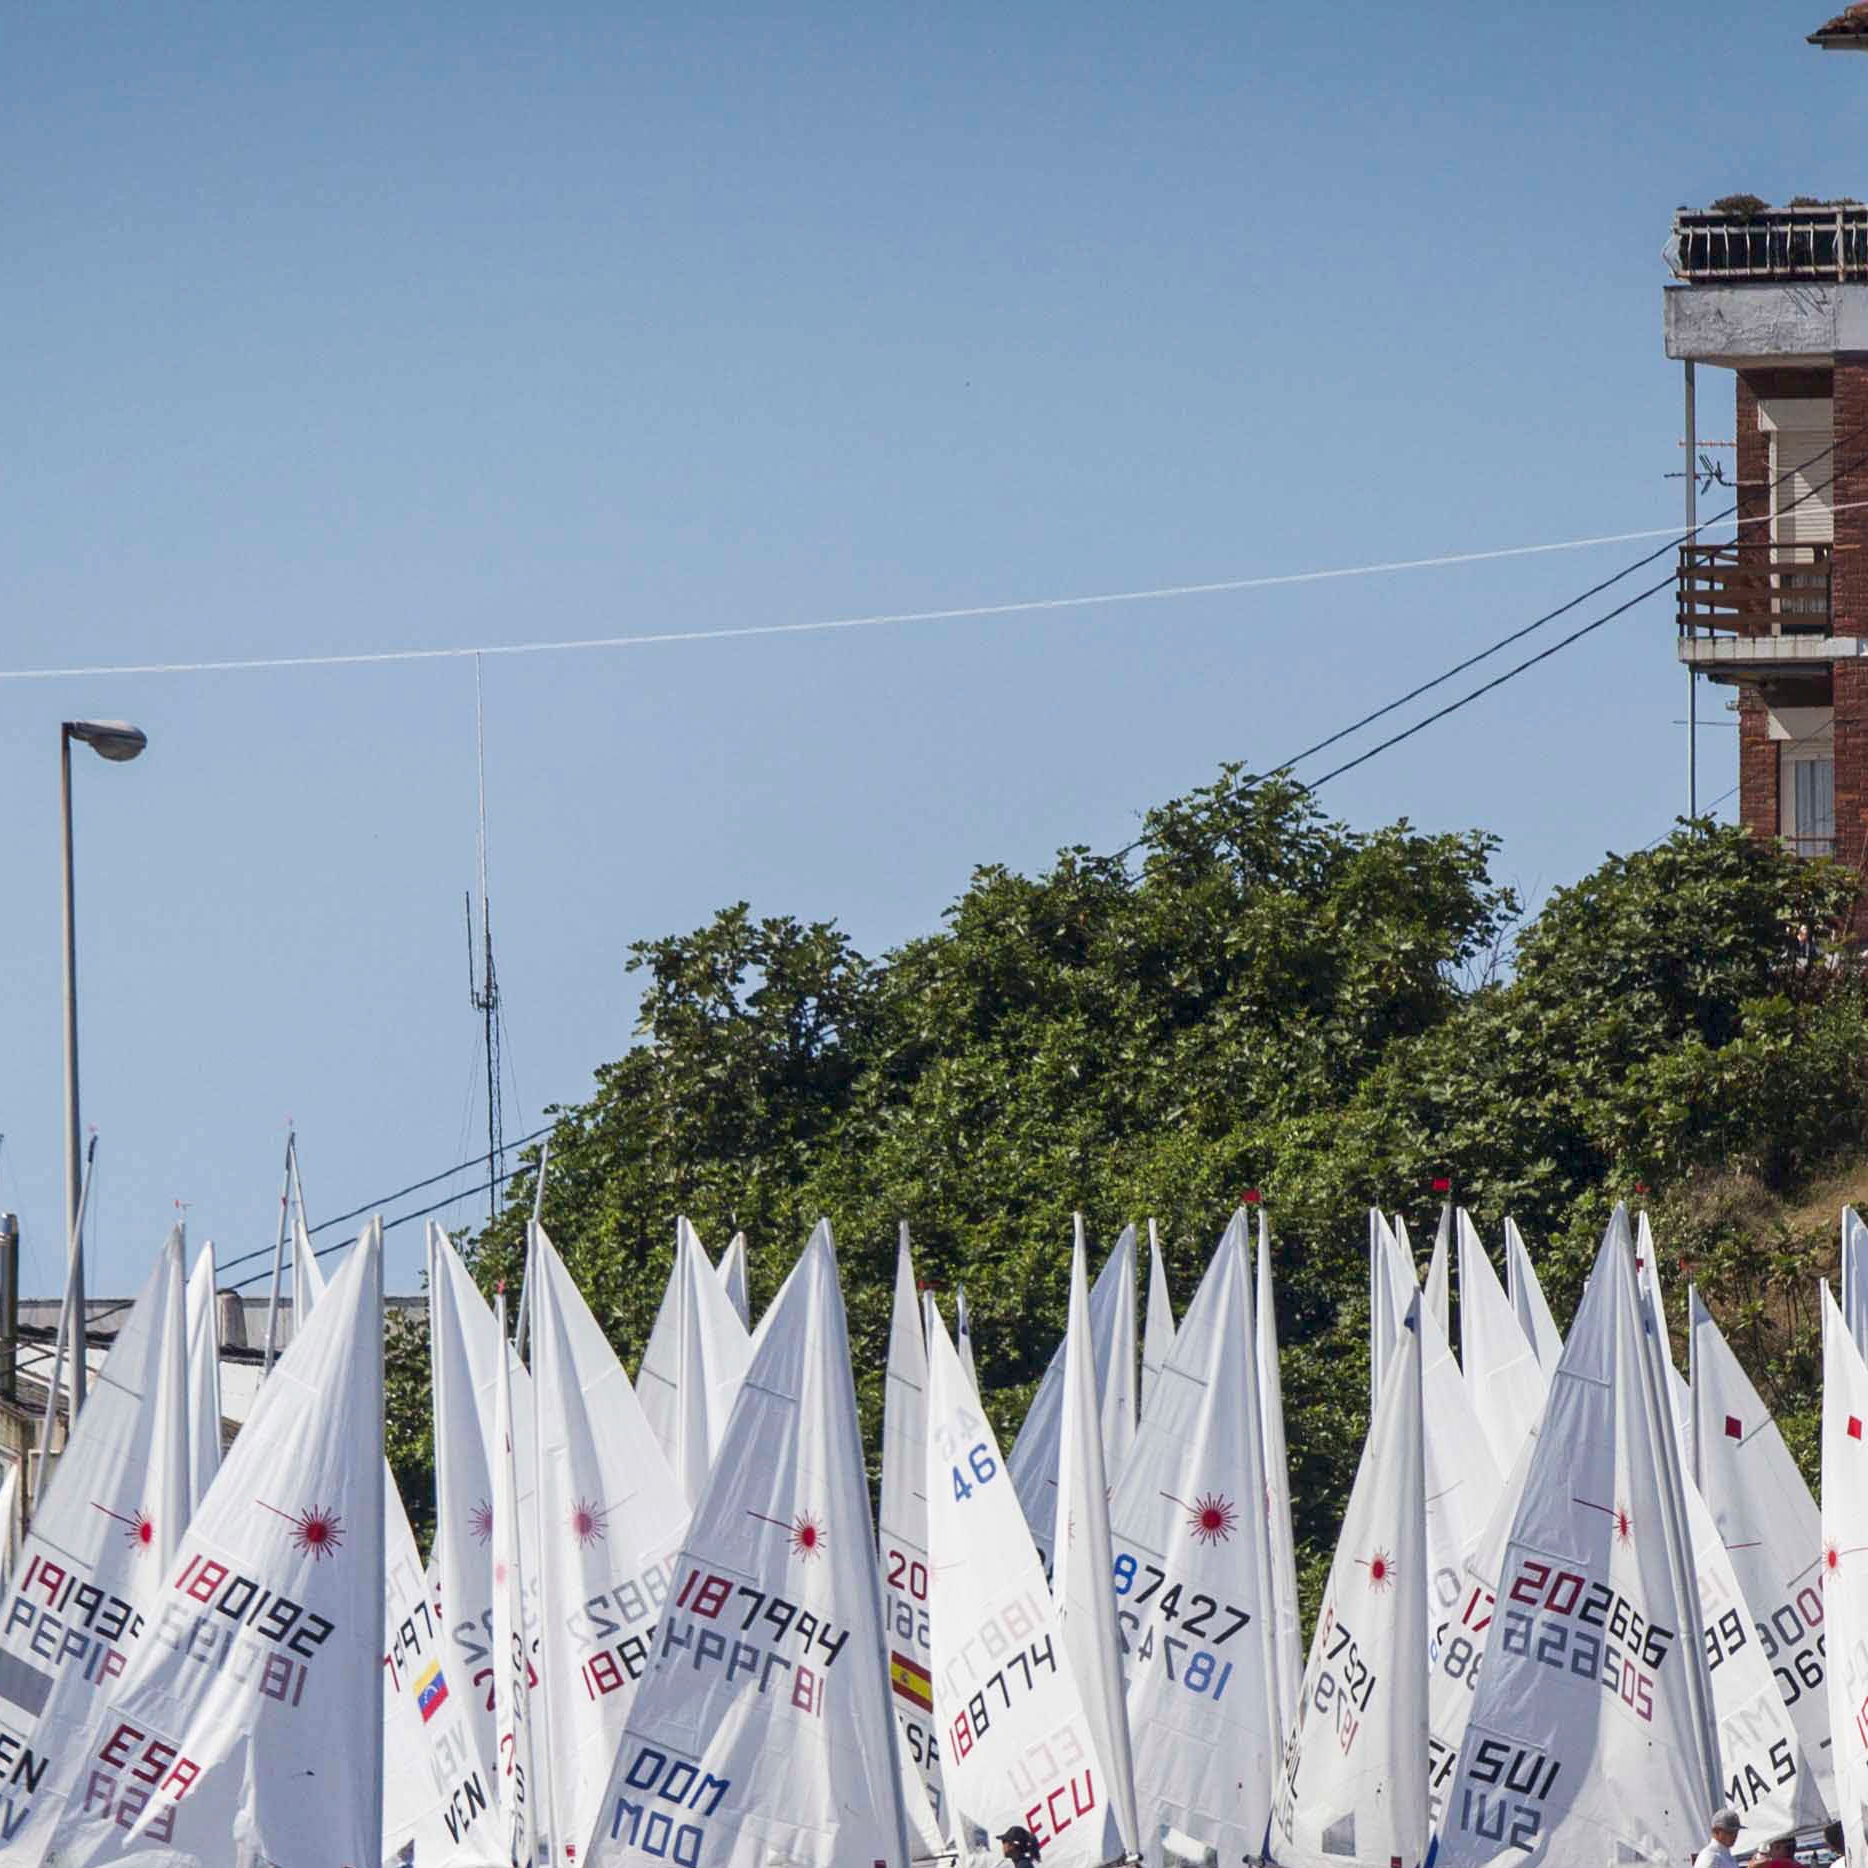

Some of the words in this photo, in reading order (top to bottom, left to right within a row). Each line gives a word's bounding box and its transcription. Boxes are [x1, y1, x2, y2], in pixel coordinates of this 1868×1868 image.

[950, 1443, 998, 1503] 46
[175, 1553, 335, 1658] 180192
[676, 1569, 850, 1667] 187994
[1509, 1560, 1675, 1670] 202656
[950, 1633, 1057, 1767] 188774
[99, 1723, 202, 1802] ESA
[625, 1747, 731, 1817] DOM
[1469, 1738, 1561, 1801] SUI
[443, 1771, 486, 1845] VEN
[1025, 1769, 1096, 1850] ECU
